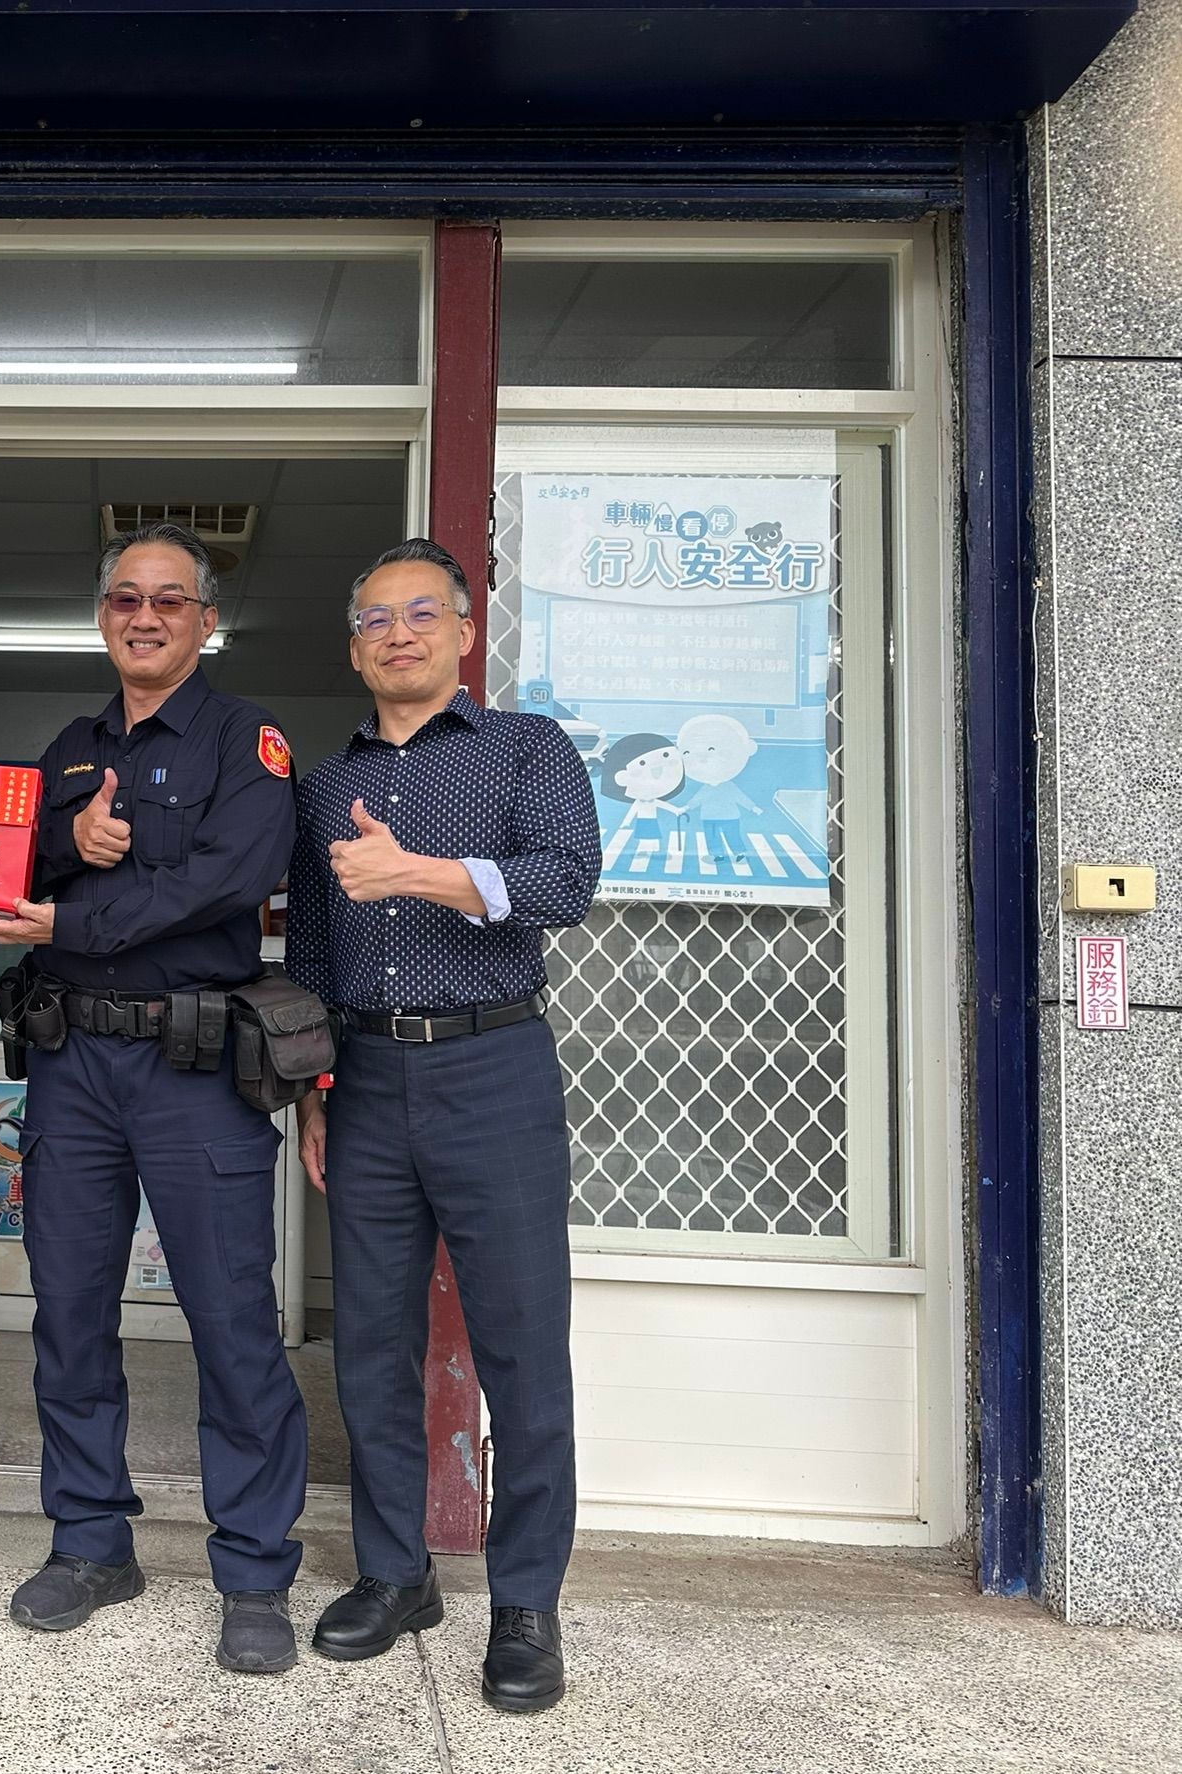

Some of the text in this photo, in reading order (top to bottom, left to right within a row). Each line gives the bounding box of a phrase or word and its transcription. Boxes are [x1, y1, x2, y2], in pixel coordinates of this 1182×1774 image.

[583, 541, 821, 590] 行人安全行
[1086, 943, 1118, 1025] 服務鈴
